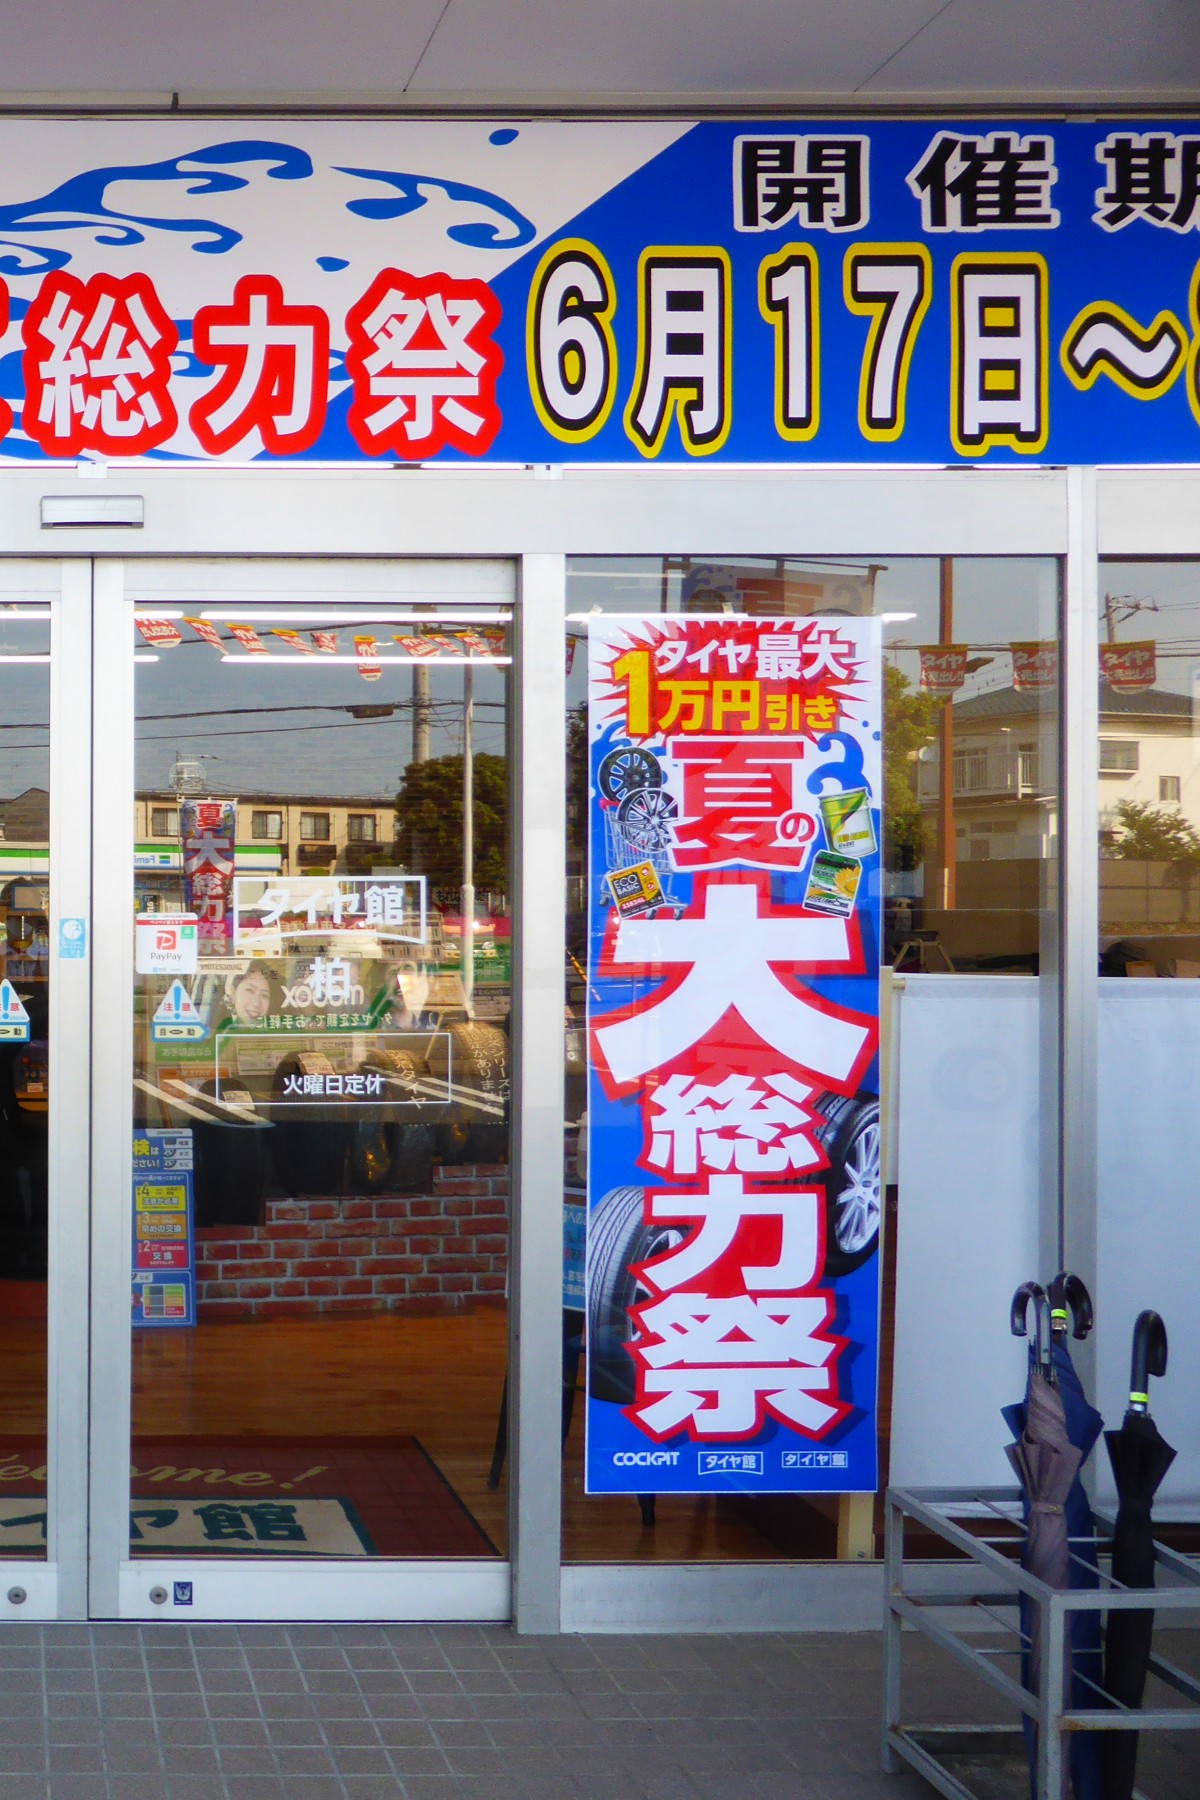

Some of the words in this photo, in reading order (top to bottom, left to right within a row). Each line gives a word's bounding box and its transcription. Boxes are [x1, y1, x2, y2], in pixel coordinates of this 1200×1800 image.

[656, 632, 852, 680] タイヤ最大
[613, 648, 838, 737] 1万円引き
[613, 873, 638, 889] ECO
[616, 882, 641, 896] BASIC
[257, 885, 404, 926] タイヤ館
[150, 952, 182, 965] PayPay
[309, 956, 352, 1000] 柏
[163, 1002, 192, 1012] 注意
[282, 1073, 385, 1095] 火曜日定休
[612, 1451, 680, 1468] COCKPIT
[705, 1454, 757, 1471] タイヤ館
[782, 1452, 848, 1469] タイヤ館
